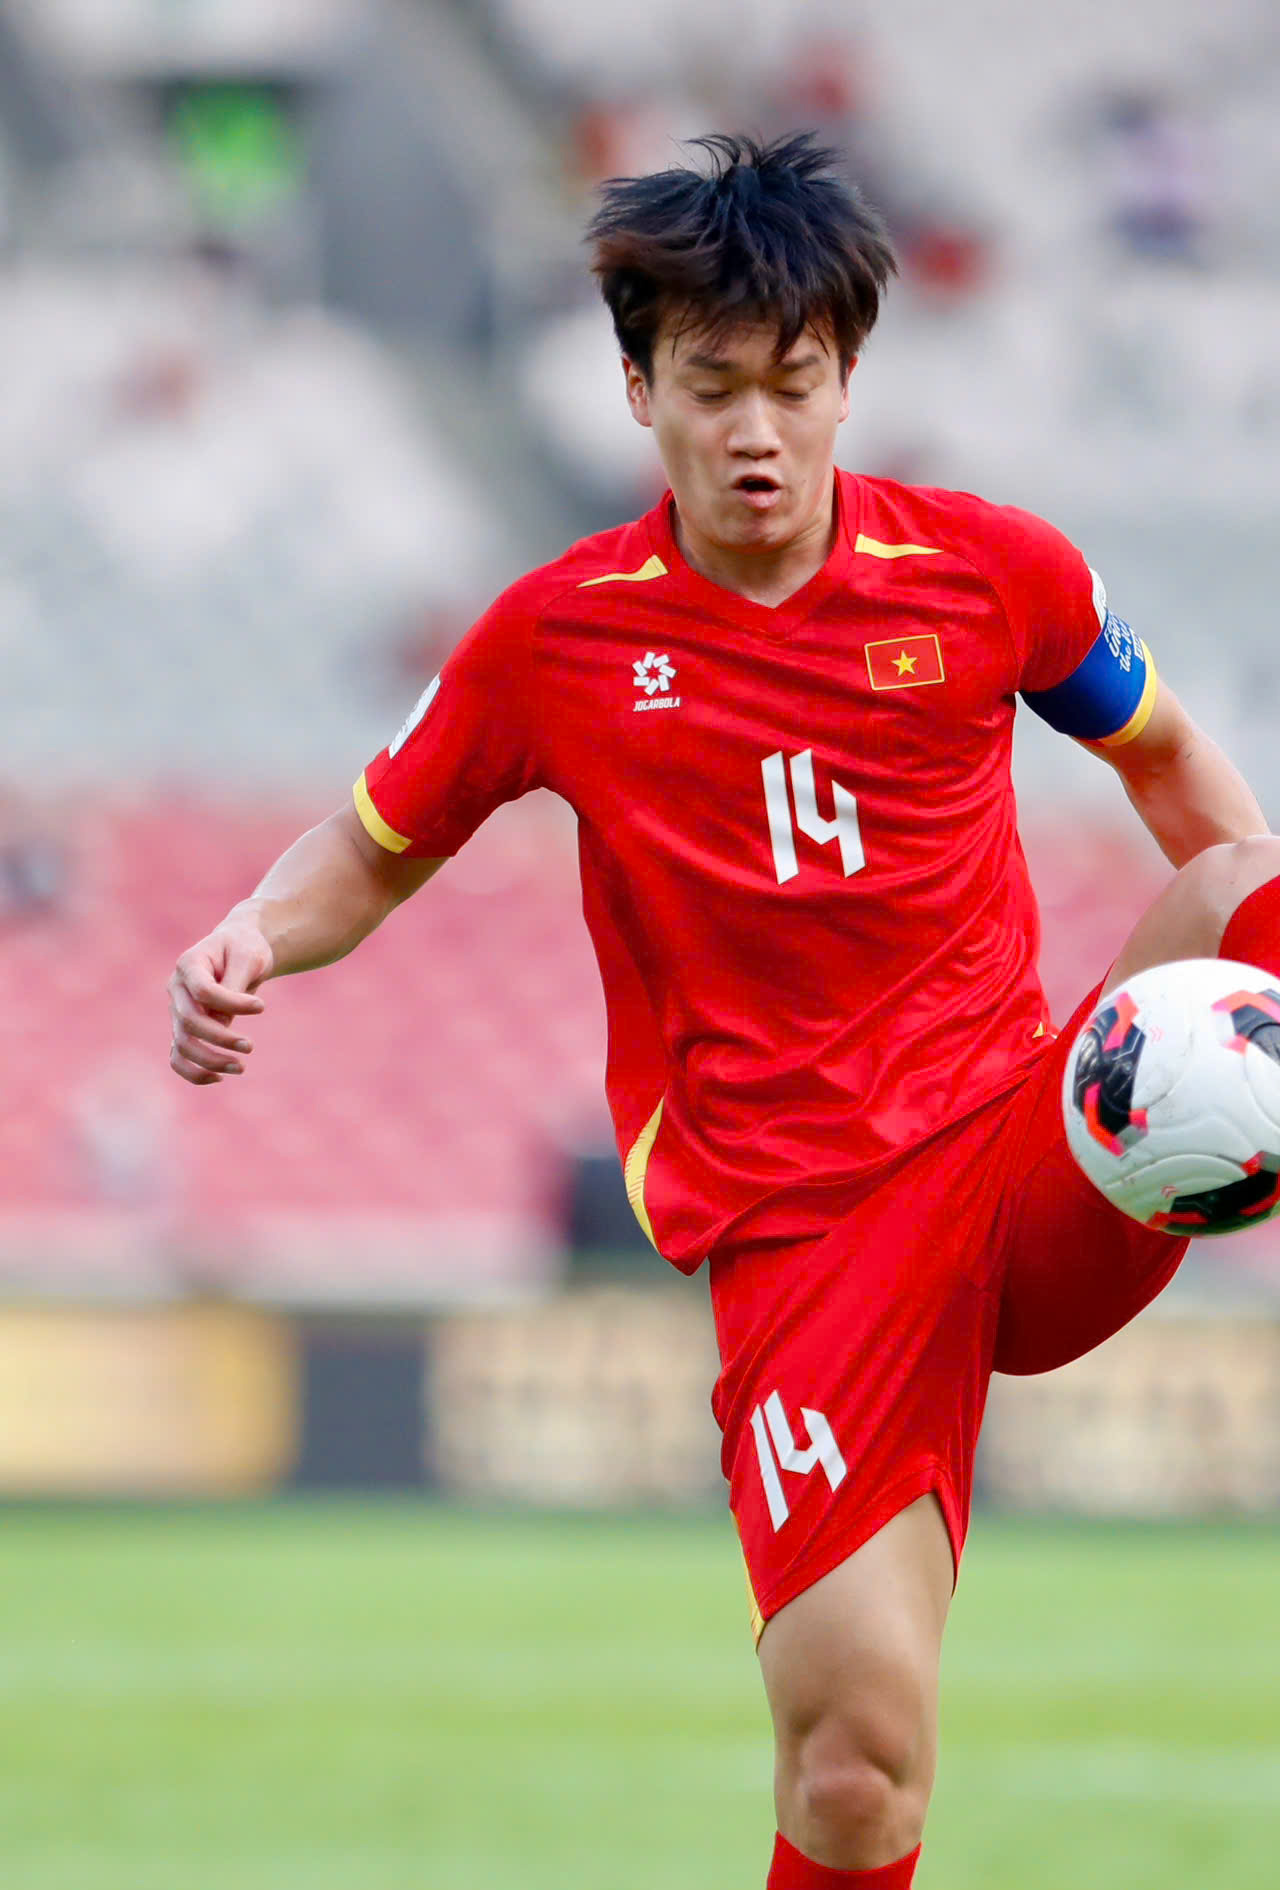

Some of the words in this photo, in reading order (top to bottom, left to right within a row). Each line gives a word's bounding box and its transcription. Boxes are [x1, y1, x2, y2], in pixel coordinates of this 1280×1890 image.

[632, 696, 681, 712] JOGARBOLA
[761, 748, 866, 885] 14
[750, 1388, 848, 1534] 14
